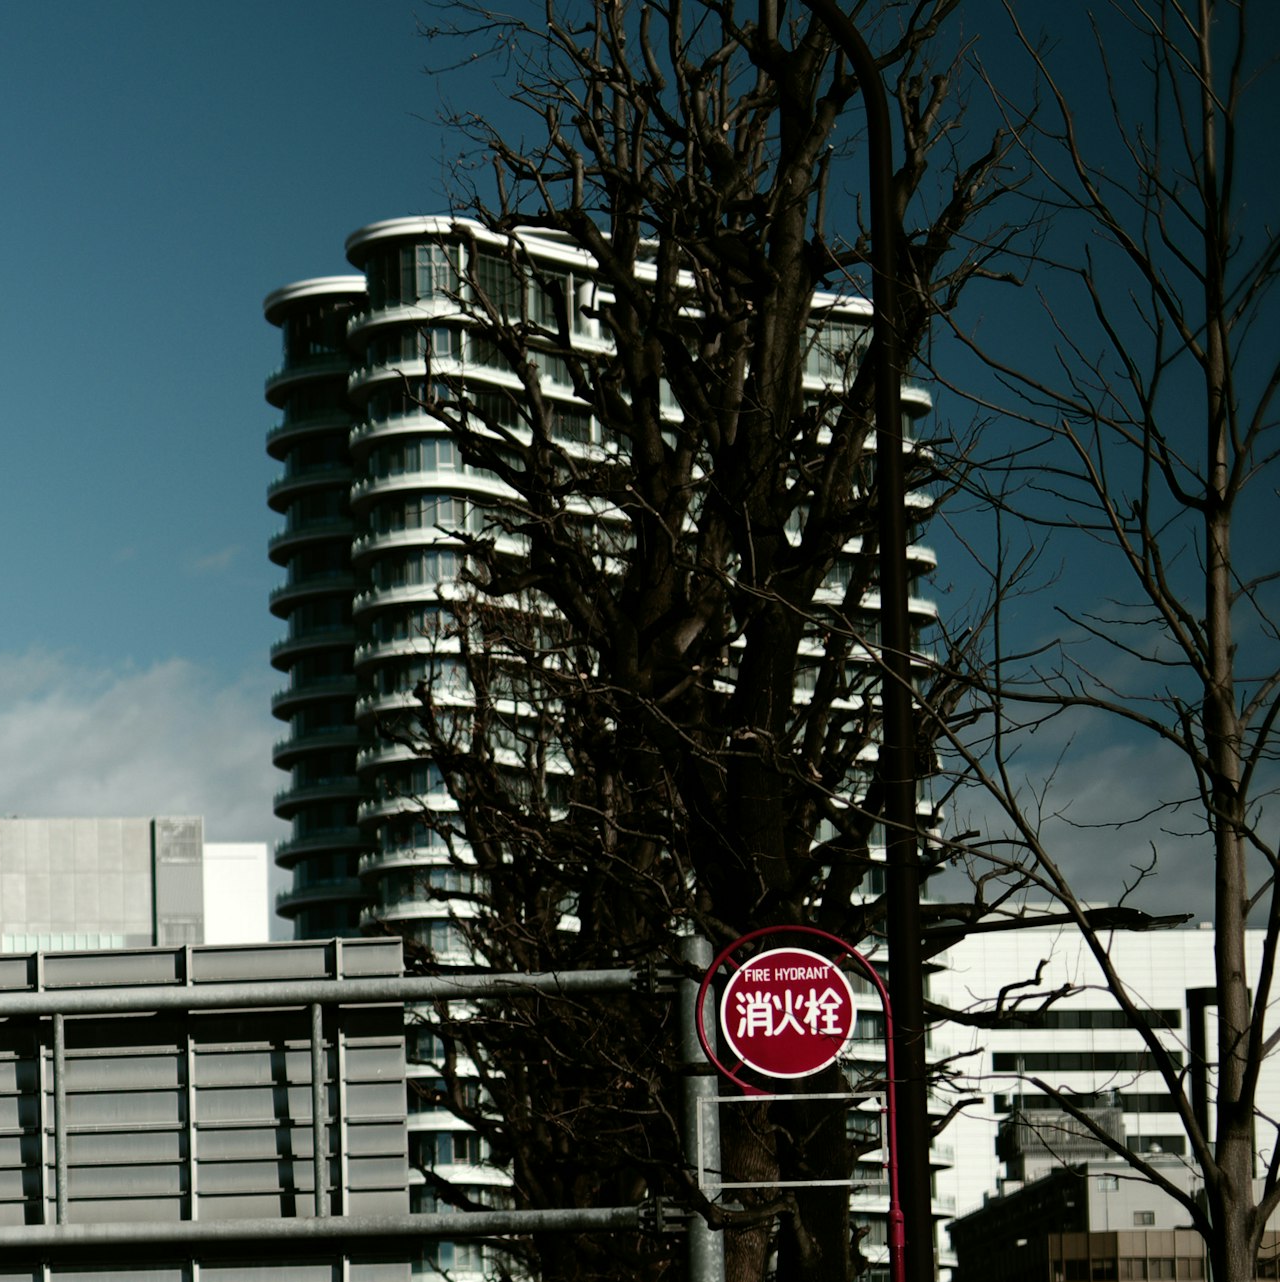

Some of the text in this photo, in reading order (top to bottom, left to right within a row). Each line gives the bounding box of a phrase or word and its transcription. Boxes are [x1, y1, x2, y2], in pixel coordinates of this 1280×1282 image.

[745, 966, 831, 982] FIRE HYDRANT
[735, 987, 843, 1038] 消火栓
